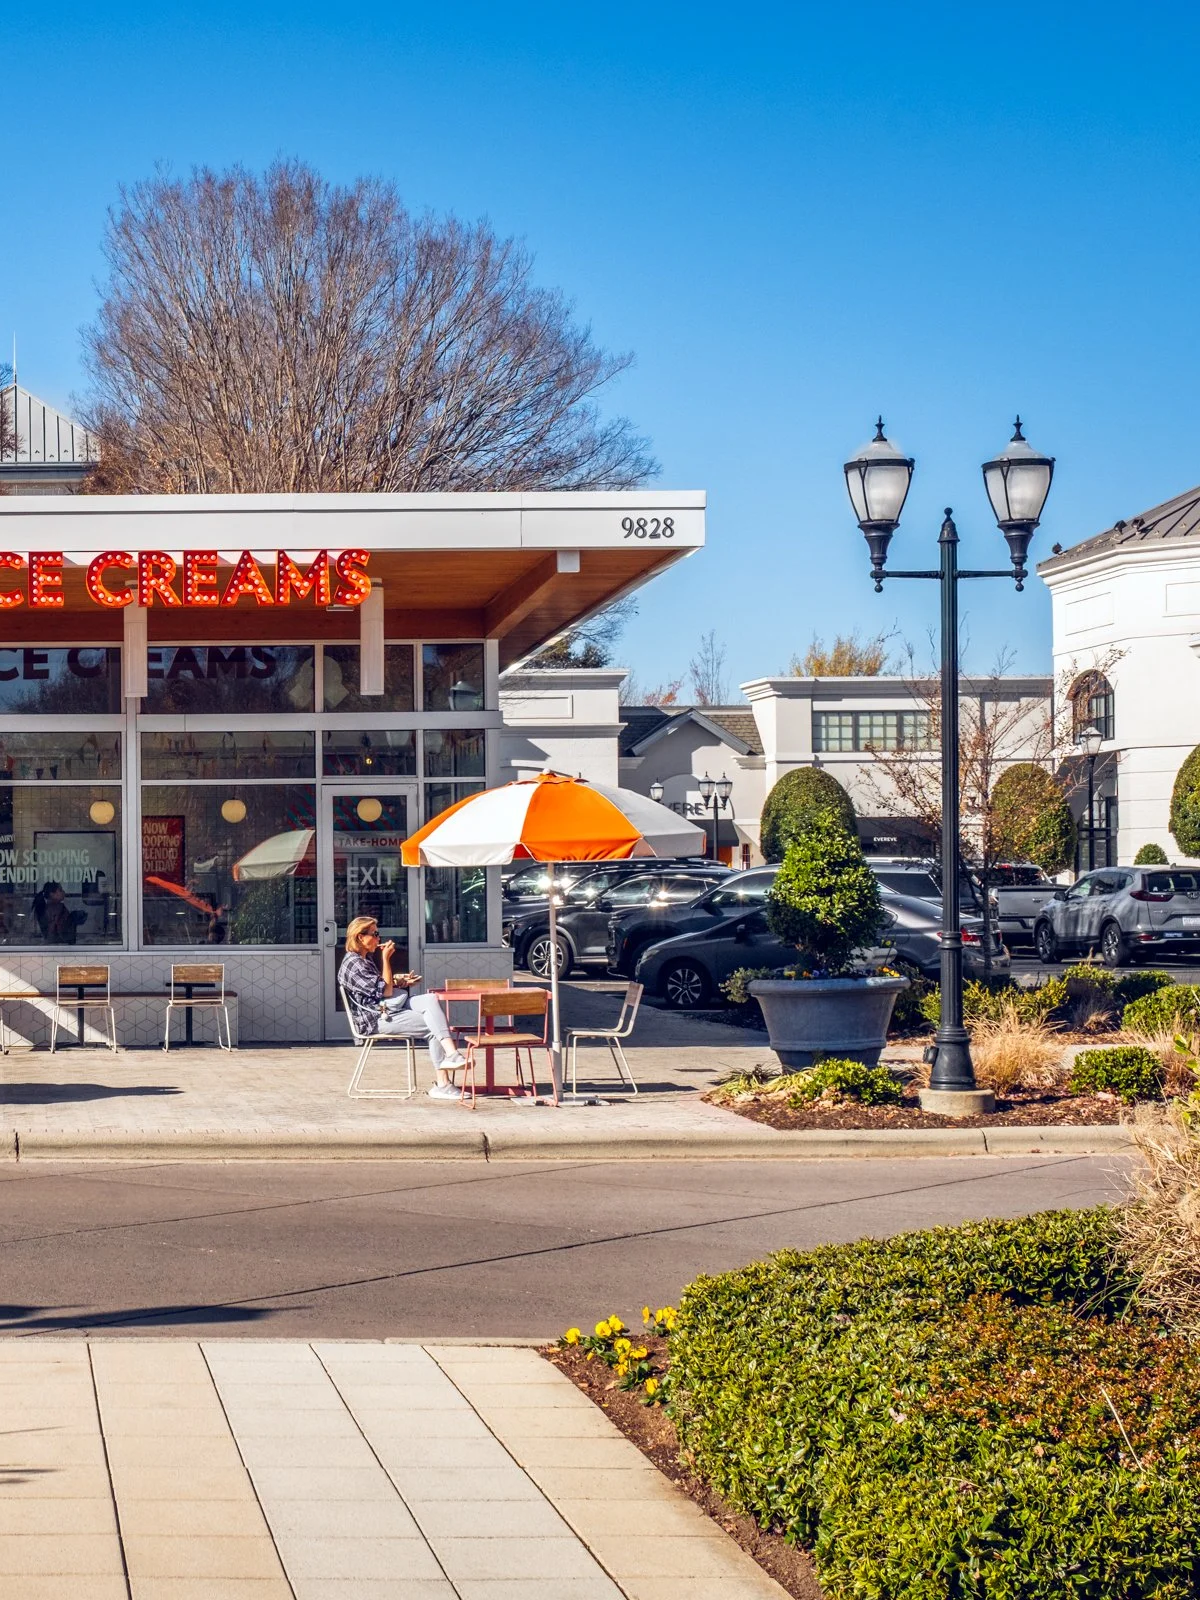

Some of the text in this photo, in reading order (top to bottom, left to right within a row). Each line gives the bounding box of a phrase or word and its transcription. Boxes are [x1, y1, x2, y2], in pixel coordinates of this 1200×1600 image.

[621, 516, 675, 539] 9828
[85, 549, 372, 609] CREAMS
[143, 822, 168, 835] NOW
[22, 849, 89, 866] SCOOPING
[43, 866, 98, 883] HOLIDAY
[347, 866, 393, 886] EXIT
